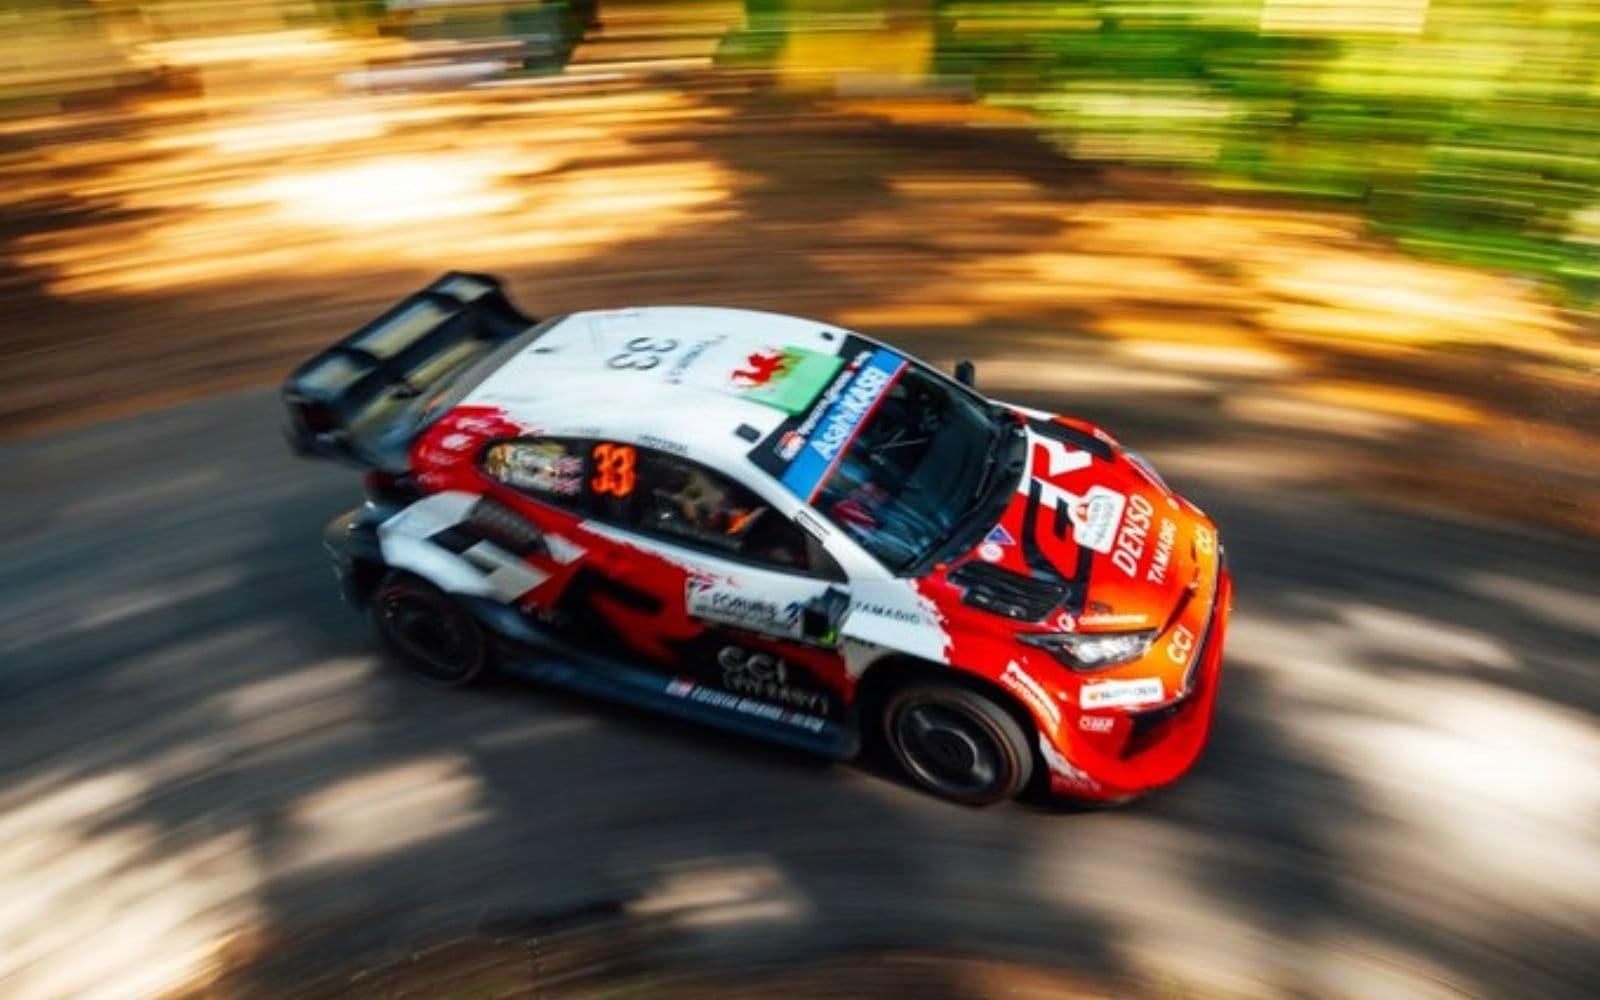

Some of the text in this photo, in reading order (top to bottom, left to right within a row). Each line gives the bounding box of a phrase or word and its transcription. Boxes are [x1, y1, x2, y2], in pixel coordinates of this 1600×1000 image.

[606, 336, 678, 372] 33
[591, 443, 637, 498] 33
[1112, 494, 1154, 578] DENSO
[1167, 625, 1195, 664] CCI
